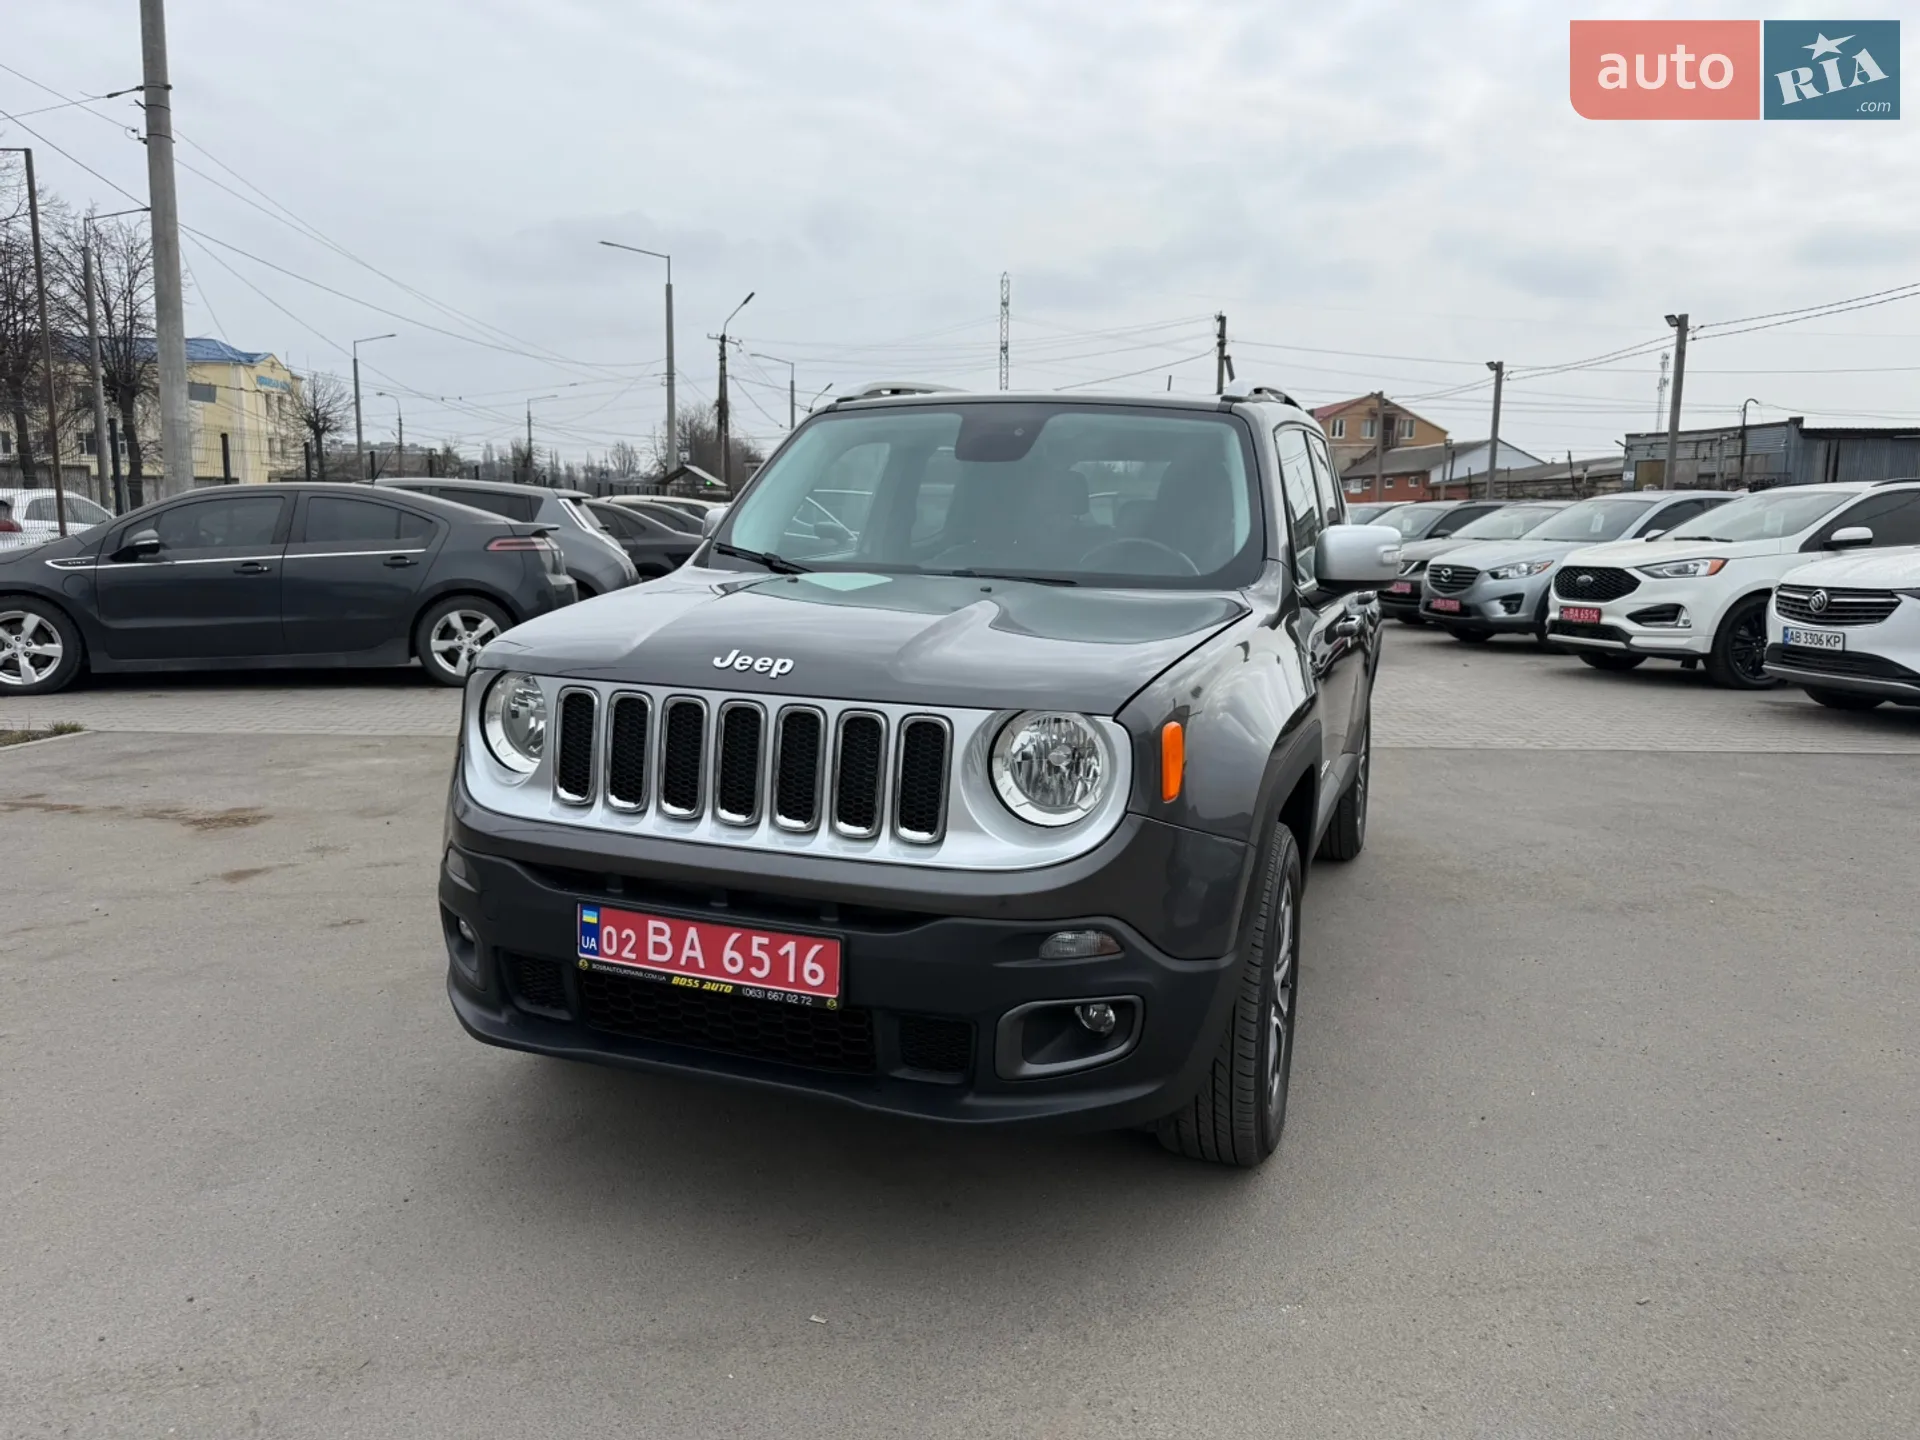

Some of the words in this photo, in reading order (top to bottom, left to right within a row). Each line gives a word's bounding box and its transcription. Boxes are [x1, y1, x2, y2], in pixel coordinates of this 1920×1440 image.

[1789, 630, 1801, 643] AB
[1803, 632, 1824, 646] 3306
[1825, 634, 1841, 648] KP
[713, 649, 794, 679] Jeep
[581, 935, 597, 951] UA
[602, 926, 637, 959] 02
[647, 920, 705, 969] BA
[722, 932, 825, 987] 6516
[671, 976, 699, 988] BOSS
[702, 980, 734, 993] AUTO
[742, 987, 765, 998] (063)
[767, 990, 784, 1001] 667
[786, 994, 798, 1004] 02
[801, 995, 813, 1005] 72
